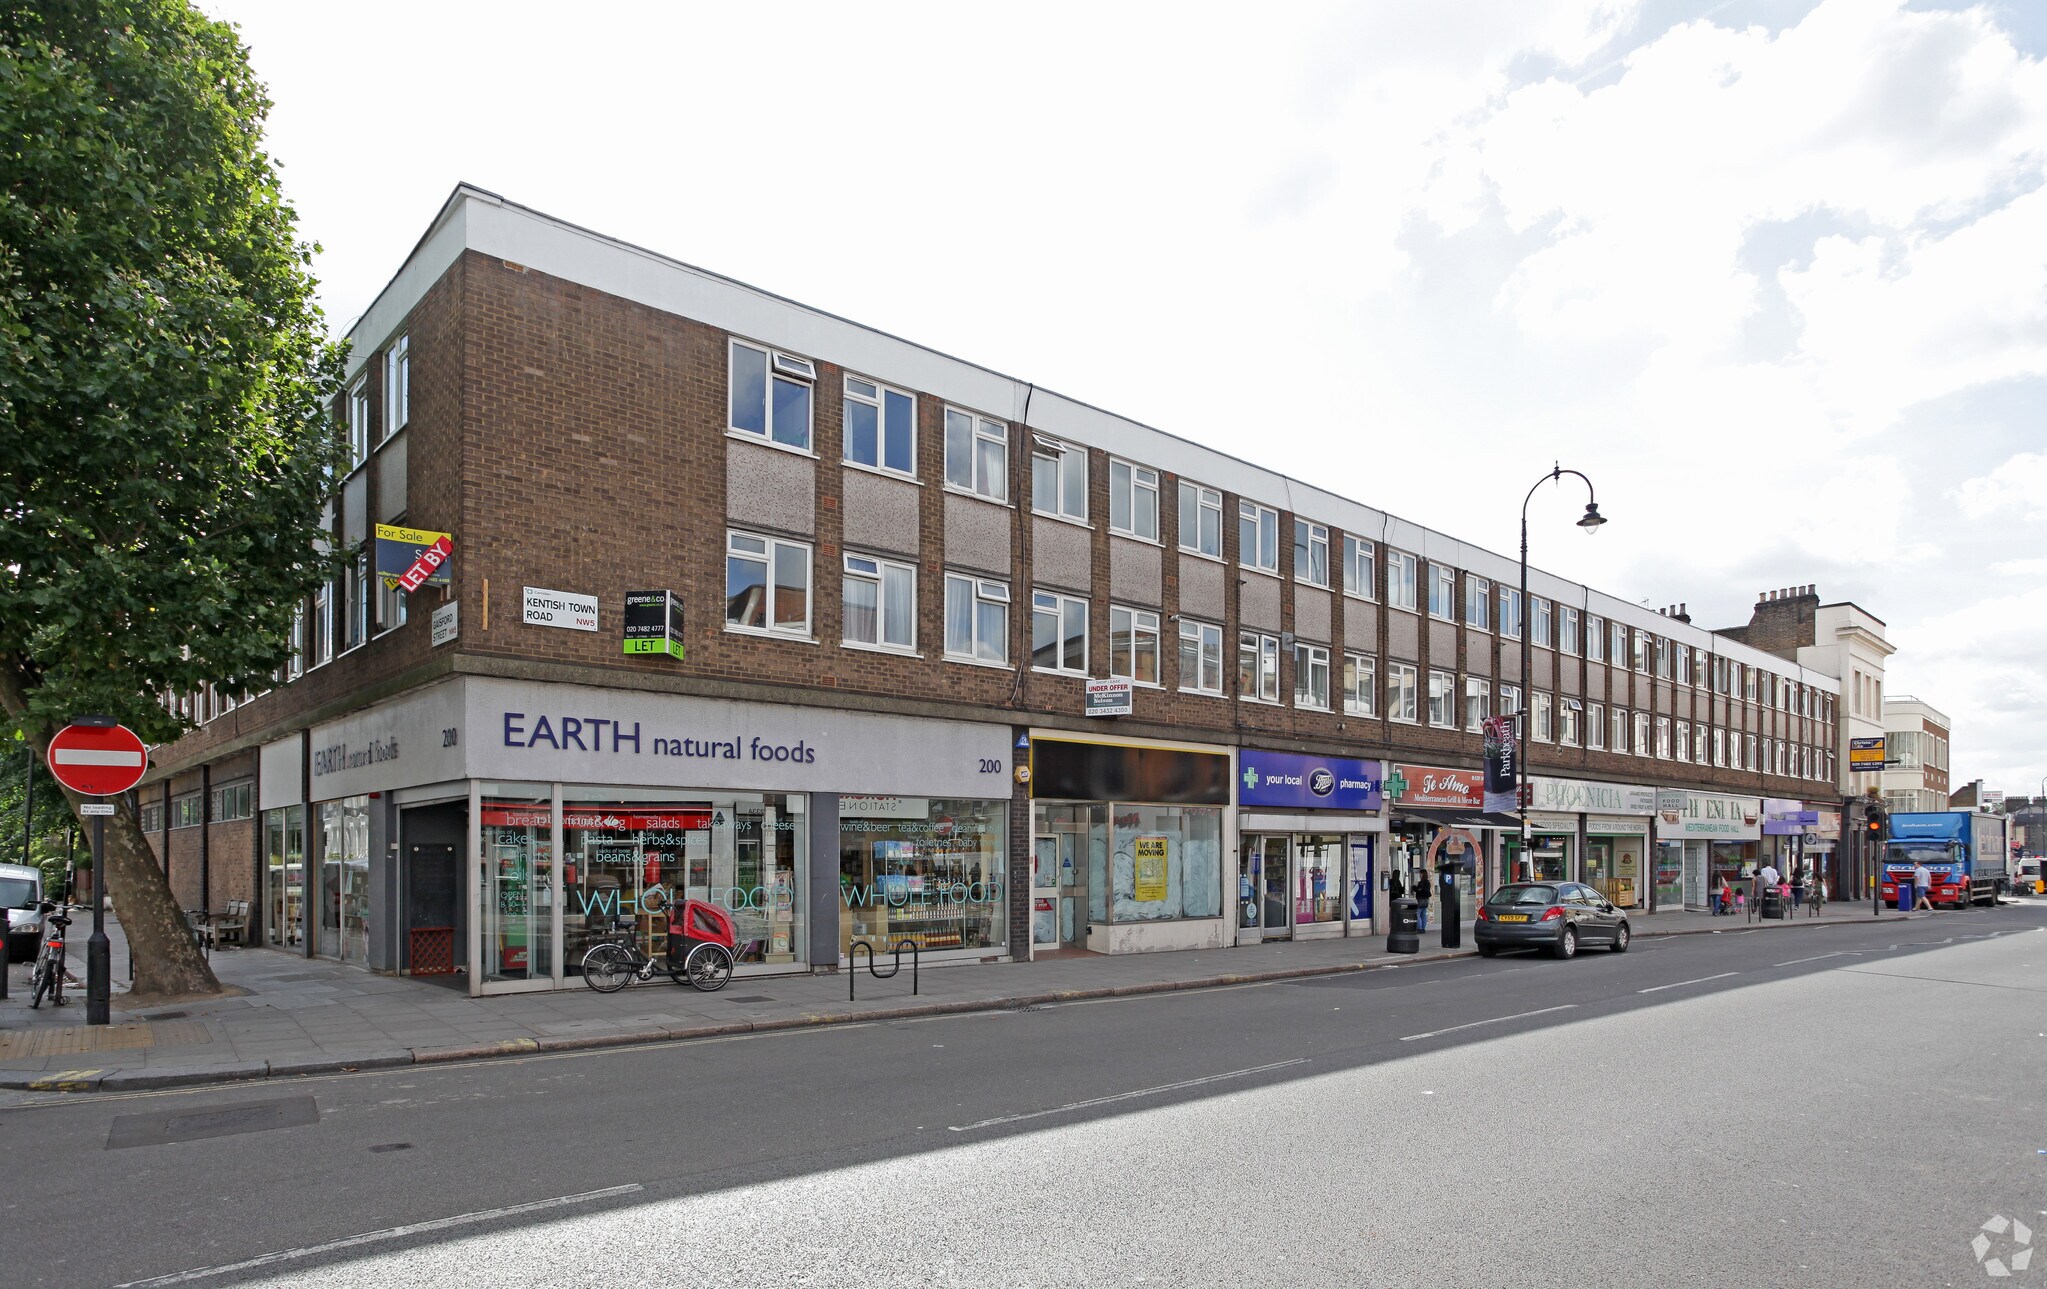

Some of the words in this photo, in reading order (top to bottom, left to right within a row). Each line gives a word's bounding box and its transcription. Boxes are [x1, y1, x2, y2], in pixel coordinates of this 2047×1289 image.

[377, 526, 395, 538] For
[399, 530, 423, 542] Sale
[400, 562, 428, 591] LET
[423, 542, 447, 568] BY
[526, 597, 566, 612] KENTISH
[568, 602, 596, 615] TOWN
[526, 610, 553, 622] ROAD
[576, 618, 596, 628] NW5
[626, 625, 637, 633] 020
[433, 628, 447, 643] STREET
[634, 640, 656, 652] LET
[672, 644, 682, 656] LET
[1109, 683, 1129, 691] OFFER
[442, 727, 458, 749] 200
[503, 712, 640, 753] EARTH
[653, 736, 741, 761] natural
[750, 736, 815, 763] foods
[315, 744, 346, 777] EARTH
[979, 758, 1002, 774] 200
[1266, 774, 1283, 786] your
[1284, 774, 1303, 786] local
[1313, 774, 1332, 791] Boots
[1339, 778, 1372, 792] pharmacy
[1423, 773, 1437, 794] Te
[1439, 773, 1470, 795] Amo
[1414, 793, 1447, 803] Mediterranean
[1447, 795, 1457, 803] Grill
[1472, 797, 1481, 805] Bar
[1545, 783, 1623, 809] PHOENICIA
[646, 816, 680, 829] salads
[696, 817, 752, 831] takeaways
[840, 821, 892, 833] wine&beer
[898, 821, 945, 833] tea&coffee
[1552, 822, 1576, 830] SPECIALITY
[1588, 822, 1602, 830] FOODS
[1602, 823, 1612, 831] FROM
[1612, 823, 1627, 831] AROUND
[1633, 824, 1645, 832] WORLD
[1684, 822, 1718, 833] MEDITERRANEAN
[1718, 824, 1730, 833] FOOD
[1730, 825, 1739, 833] HALL
[580, 834, 614, 849] pasta
[631, 833, 708, 849] herbs&spices
[915, 838, 952, 847] toiletries
[1139, 841, 1150, 849] WE
[1150, 841, 1163, 849] ARE
[595, 849, 675, 865] beans&grains
[1137, 849, 1165, 857] MOVING
[840, 883, 933, 909] WHOLE
[940, 881, 1003, 906] FOOD
